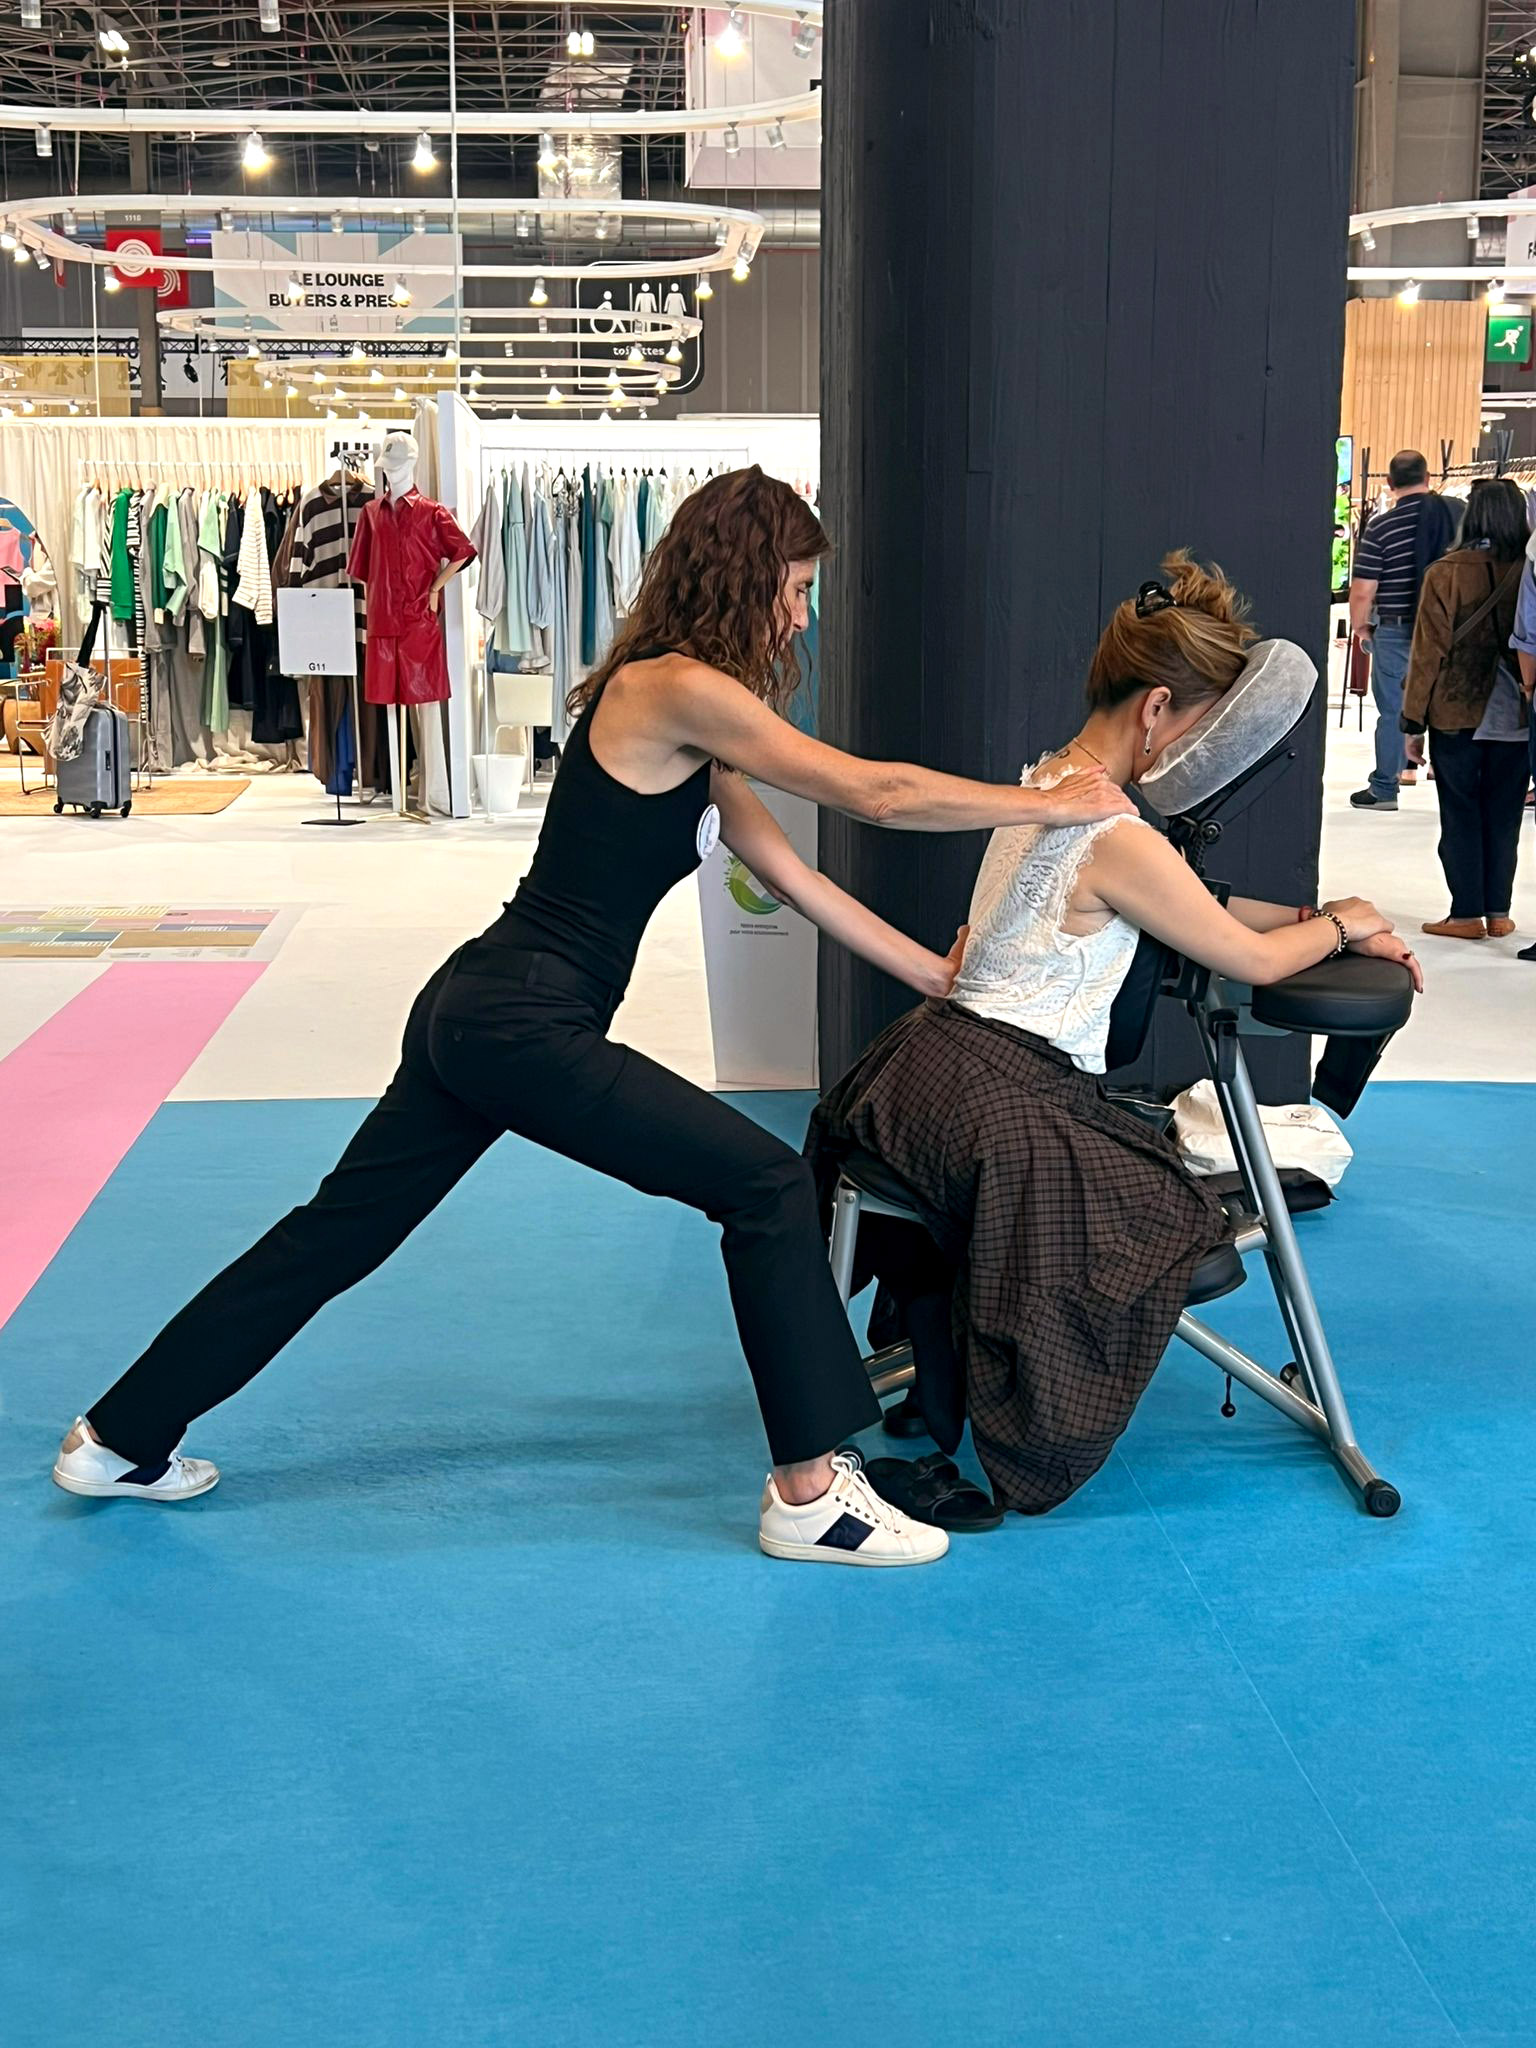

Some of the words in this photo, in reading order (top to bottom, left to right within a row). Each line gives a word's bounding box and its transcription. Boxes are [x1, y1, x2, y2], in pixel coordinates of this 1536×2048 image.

[298, 273, 313, 286] E
[316, 273, 384, 287] LOUNGE
[269, 293, 337, 307] BUERS
[340, 294, 352, 307] &
[613, 345, 665, 356] toittes
[308, 662, 326, 671] G11
